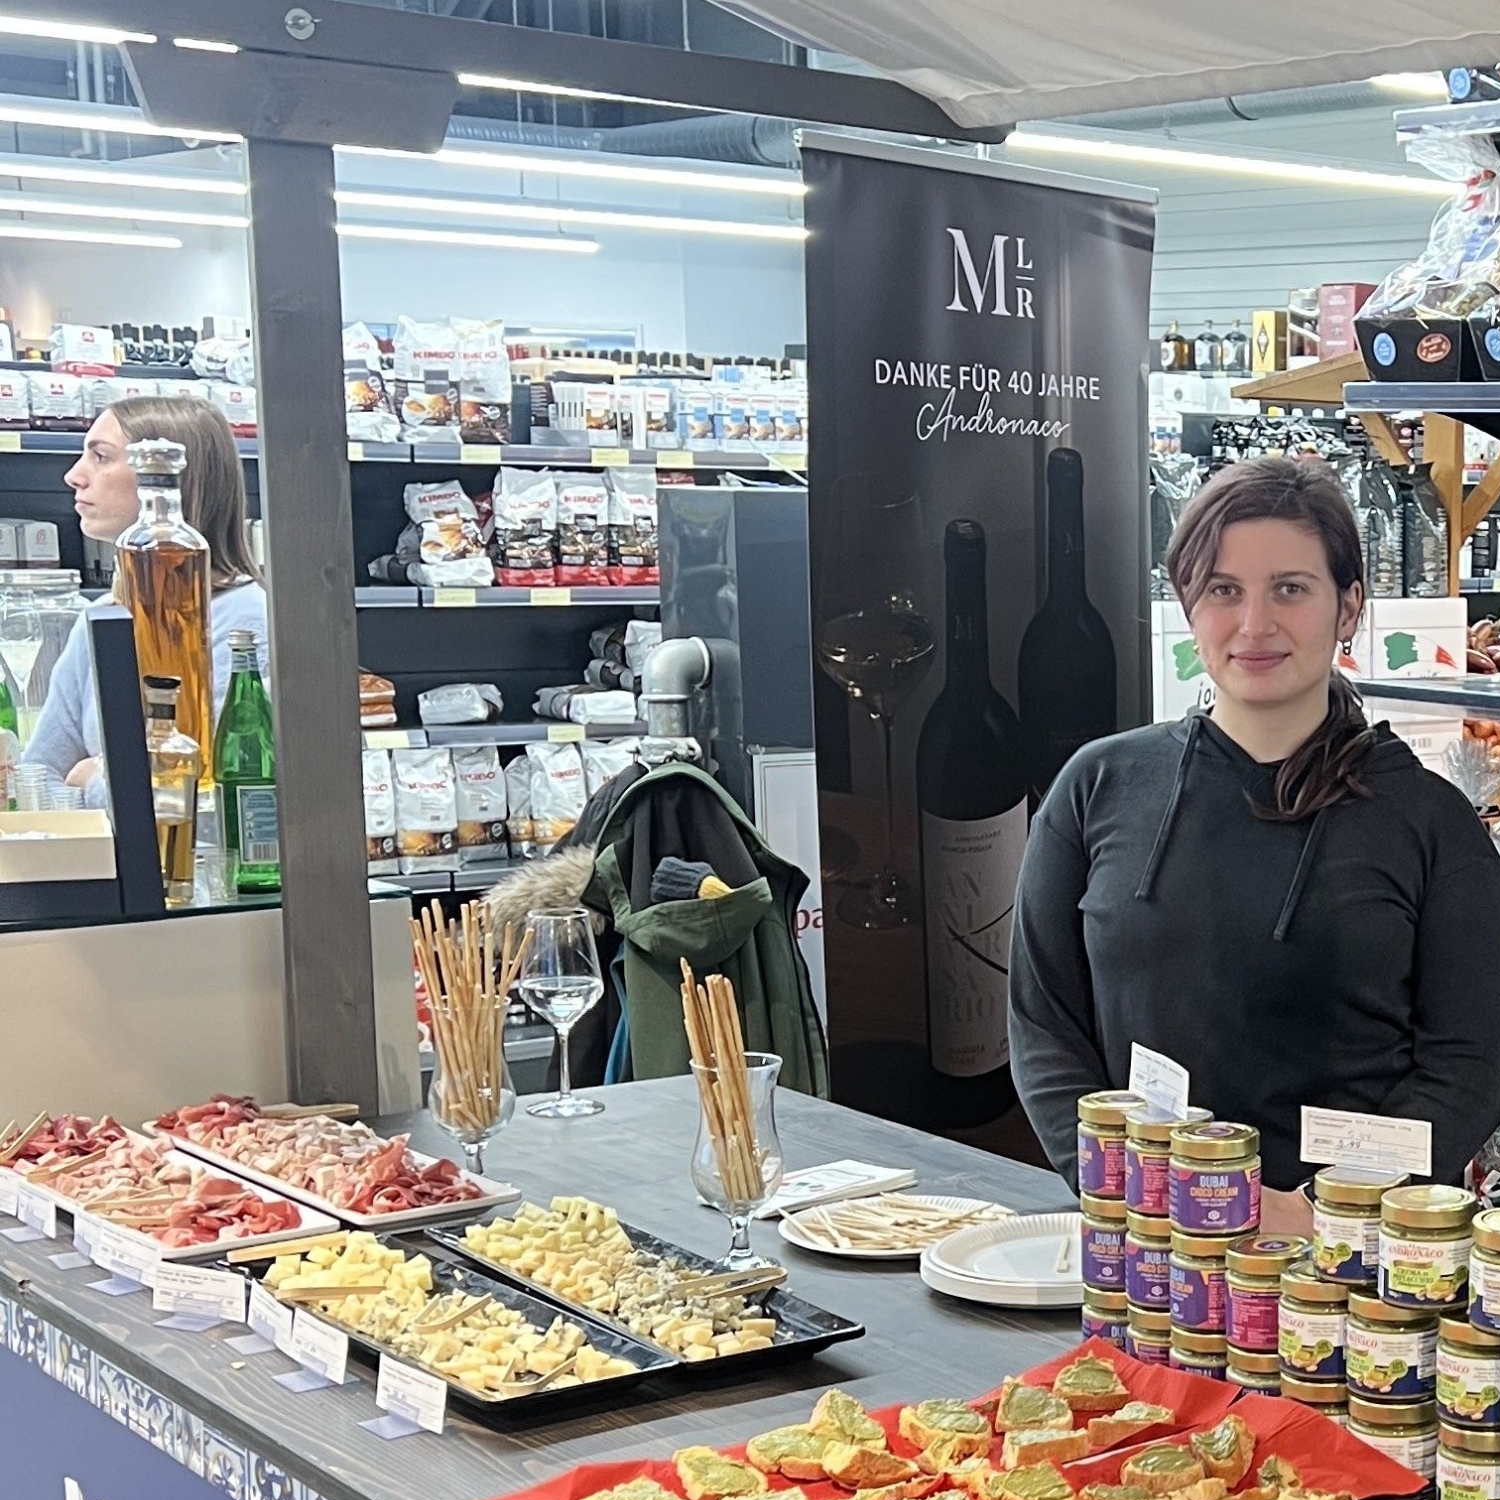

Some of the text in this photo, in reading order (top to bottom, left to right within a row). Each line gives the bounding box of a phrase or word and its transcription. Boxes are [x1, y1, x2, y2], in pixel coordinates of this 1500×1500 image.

[1016, 237, 1034, 270] L
[946, 227, 1011, 317] M
[1016, 287, 1036, 319] R
[412, 350, 455, 360] KIMBO
[874, 359, 1101, 401] DANKE FÜR 40 JAHRE
[916, 386, 1071, 442] Andronaco
[418, 492, 462, 505] KIMBO
[563, 494, 604, 505] KIMBO
[1199, 1175, 1229, 1187] DUBAI
[1214, 1186, 1239, 1198] CREAM
[1094, 1233, 1121, 1245] DUBAI
